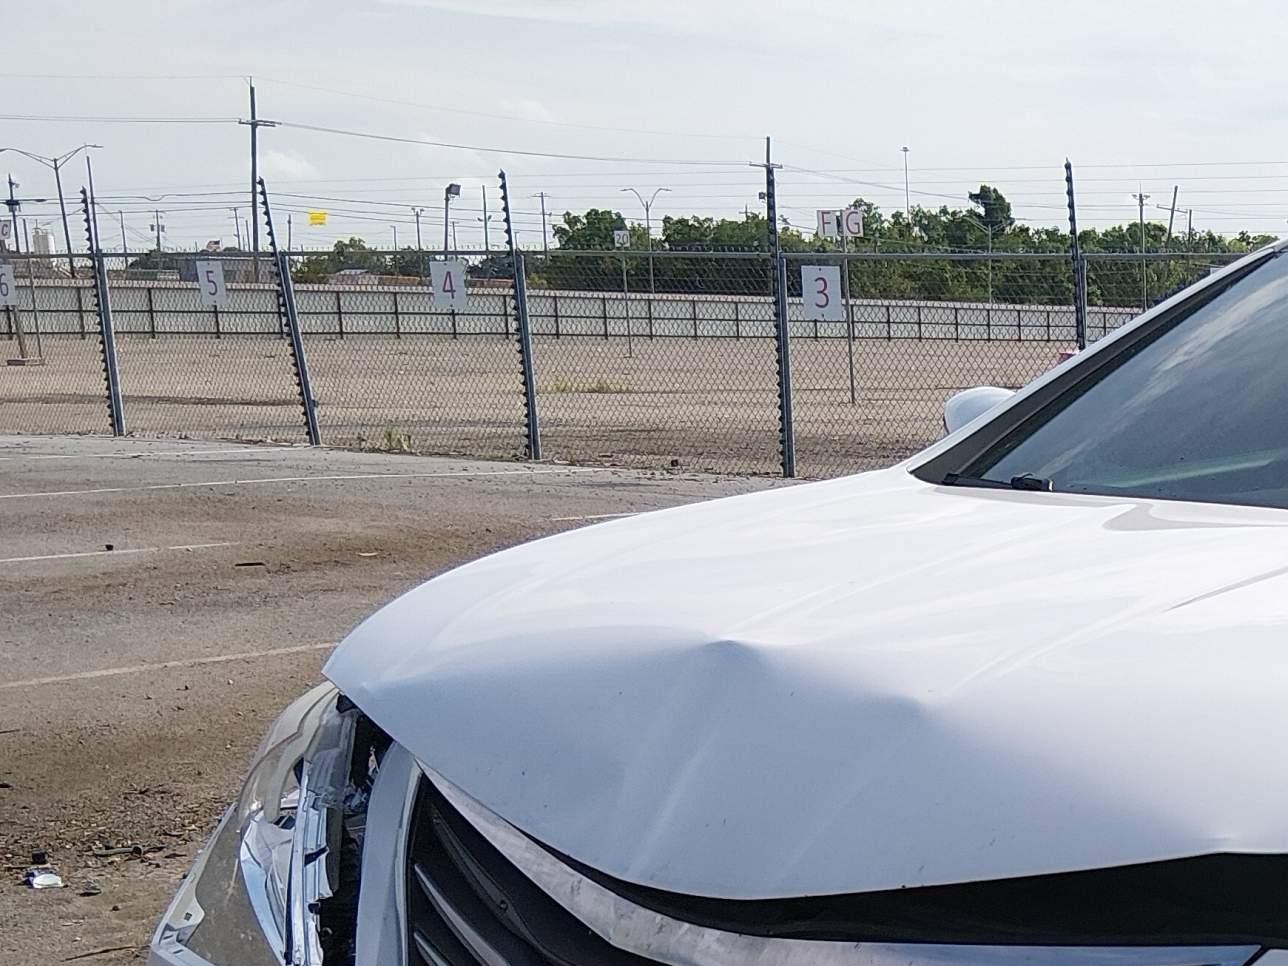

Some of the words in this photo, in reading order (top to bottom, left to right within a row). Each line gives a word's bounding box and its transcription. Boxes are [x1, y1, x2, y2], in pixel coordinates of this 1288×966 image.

[820, 211, 832, 235] F
[846, 211, 861, 235] G
[615, 233, 629, 244] 20
[0, 272, 9, 297] 6
[205, 270, 218, 296] 5
[442, 270, 456, 299] 4
[814, 276, 830, 309] 3
